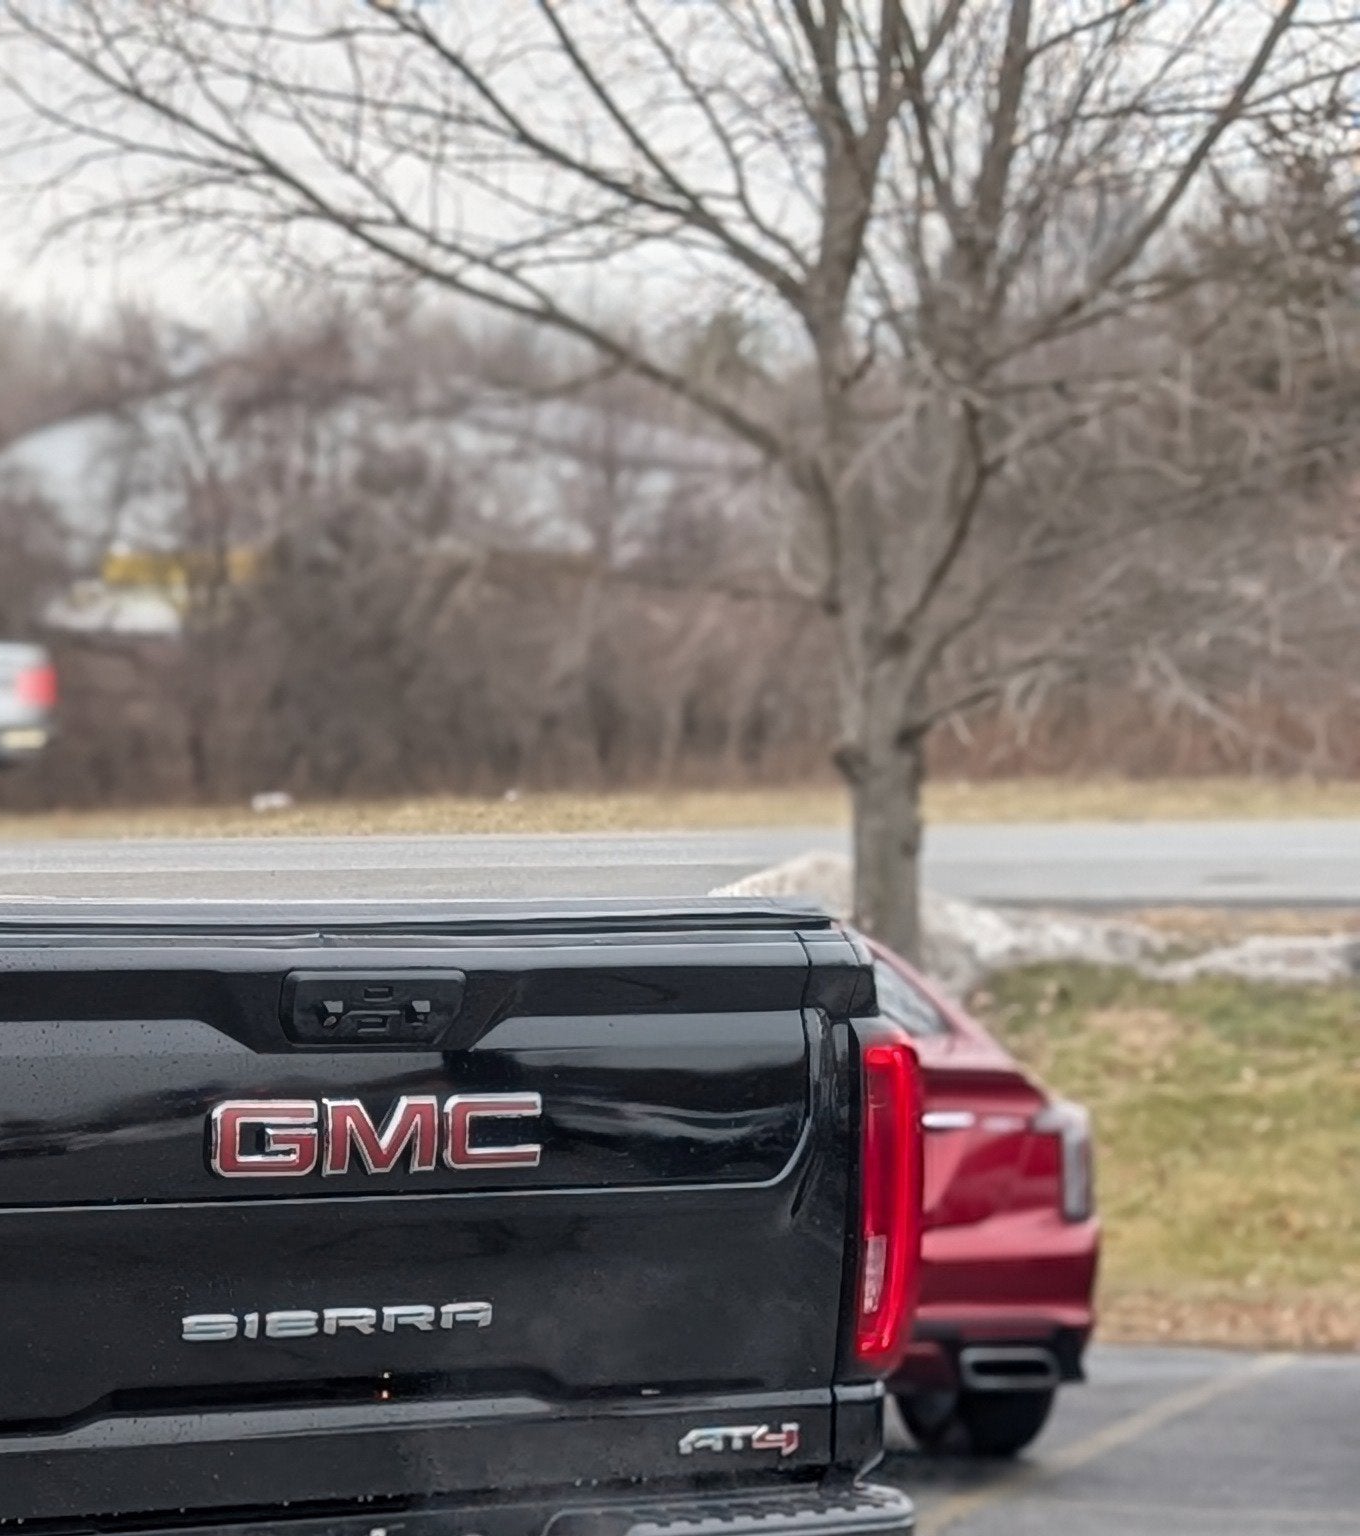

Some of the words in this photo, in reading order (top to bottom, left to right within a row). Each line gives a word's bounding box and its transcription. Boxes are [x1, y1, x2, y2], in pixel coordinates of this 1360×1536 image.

[210, 1092, 542, 1178] GMC
[181, 1301, 493, 1342] SIERRA
[678, 1422, 800, 1457] AT4
